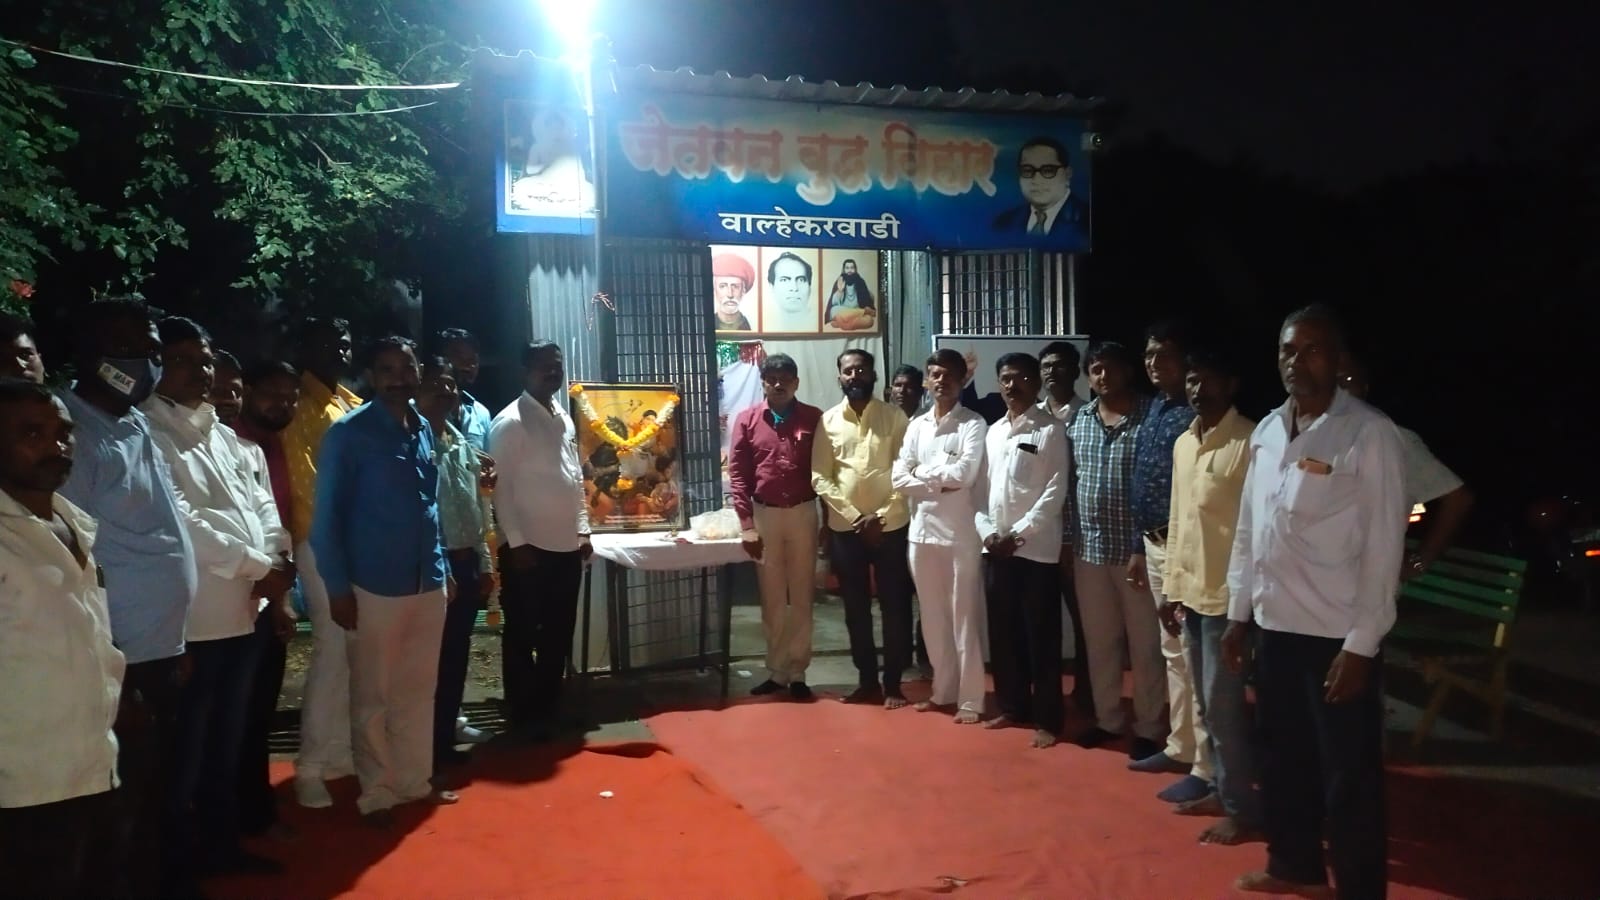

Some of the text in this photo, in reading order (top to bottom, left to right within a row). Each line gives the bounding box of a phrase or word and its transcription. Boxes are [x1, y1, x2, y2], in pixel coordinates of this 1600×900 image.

[619, 105, 783, 182] जेतवन
[881, 122, 997, 196] विहार
[718, 206, 901, 239] वाल्हेकरवाडी
